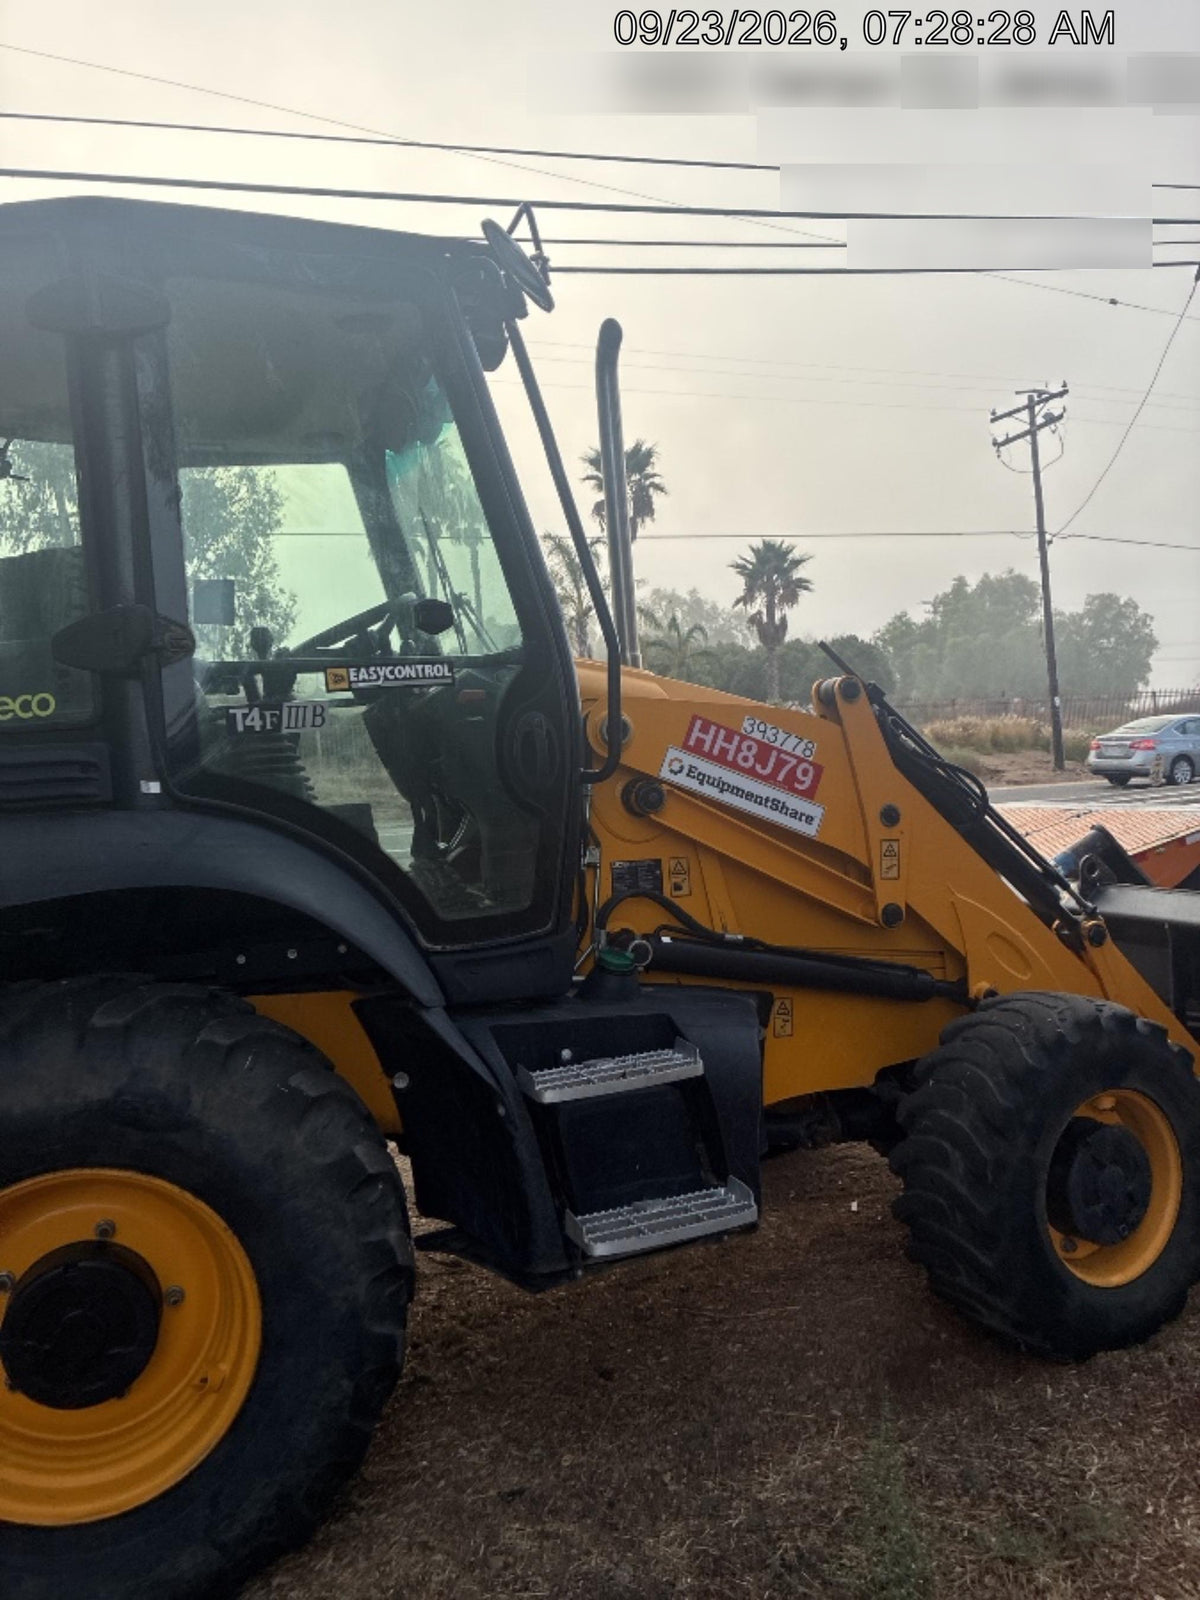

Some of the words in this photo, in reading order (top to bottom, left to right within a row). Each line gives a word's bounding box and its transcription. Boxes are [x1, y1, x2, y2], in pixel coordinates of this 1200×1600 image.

[349, 664, 452, 684] EASYCONTROL
[688, 719, 815, 791] HH8J79
[743, 717, 815, 758] 393778
[685, 763, 815, 826] EquipmentShare
